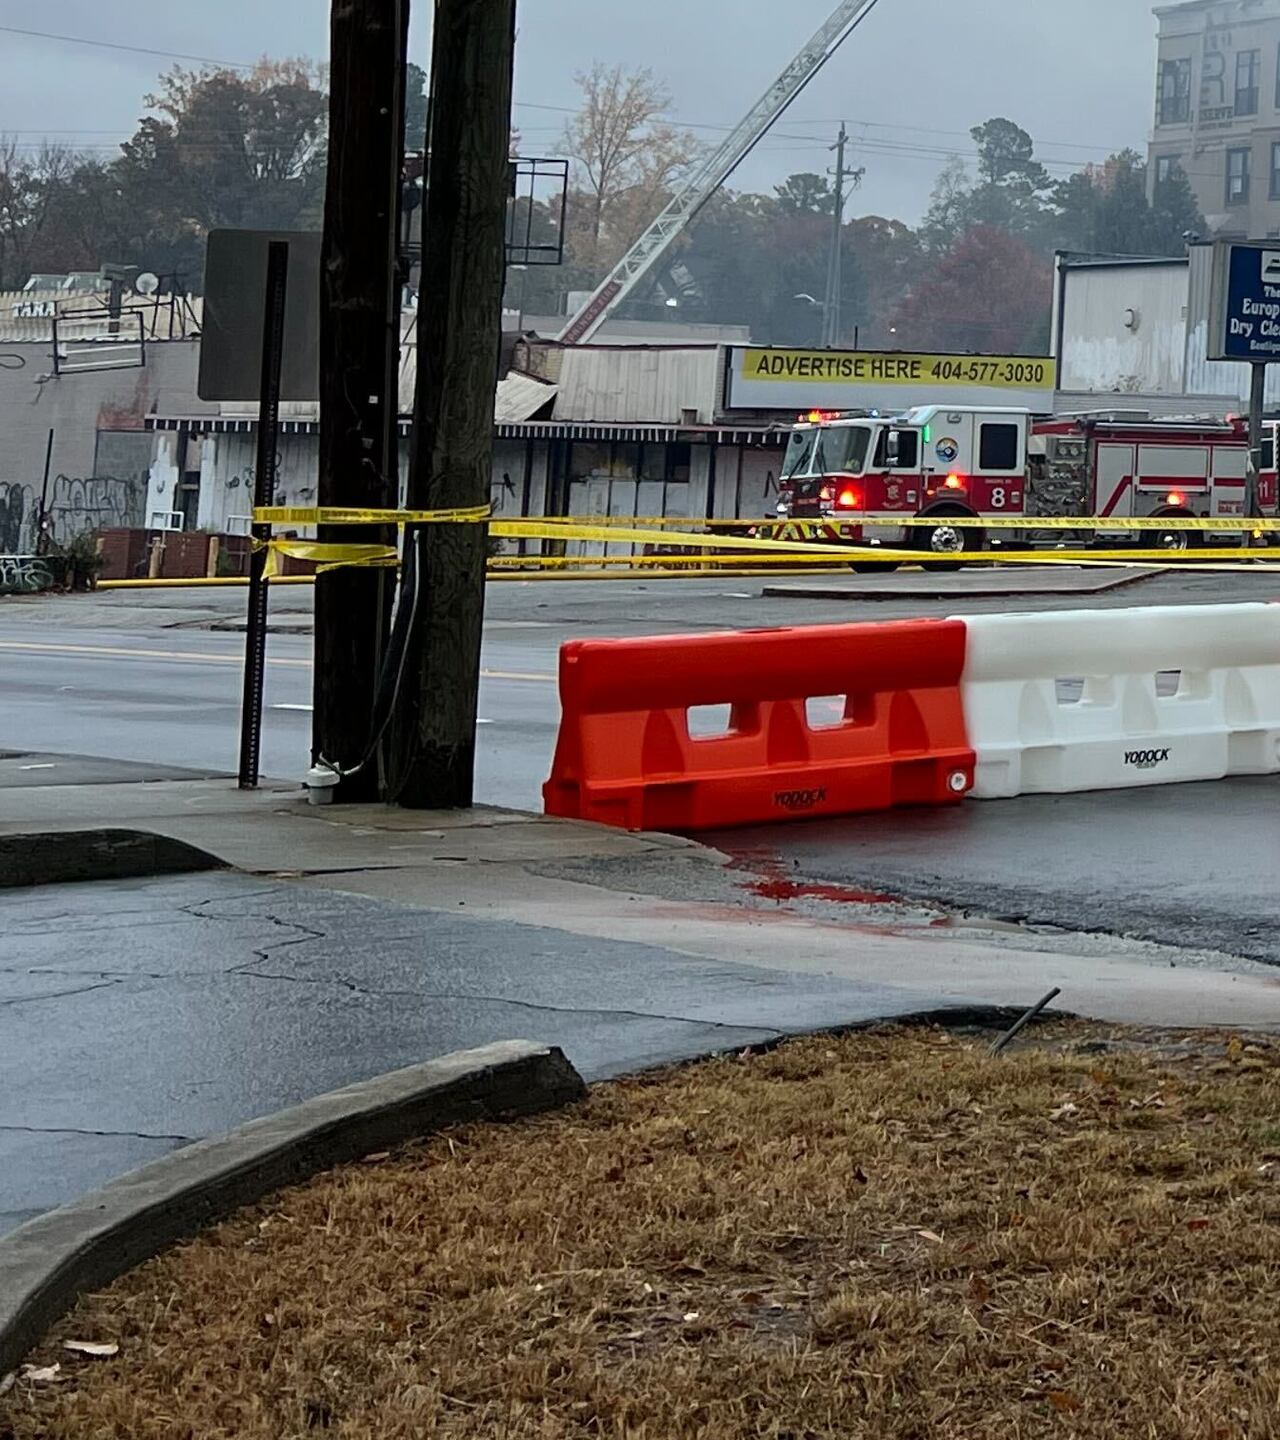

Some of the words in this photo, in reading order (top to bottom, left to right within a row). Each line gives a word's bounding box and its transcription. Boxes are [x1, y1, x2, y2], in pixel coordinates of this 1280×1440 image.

[1230, 318, 1253, 338] Dry
[757, 355, 865, 377] ADVERTISE
[871, 359, 922, 378] HERE
[931, 361, 1043, 383] 404-577-3030
[991, 487, 1005, 508] 8
[1124, 748, 1171, 764] YODOCK
[774, 789, 826, 807] YODOCK
